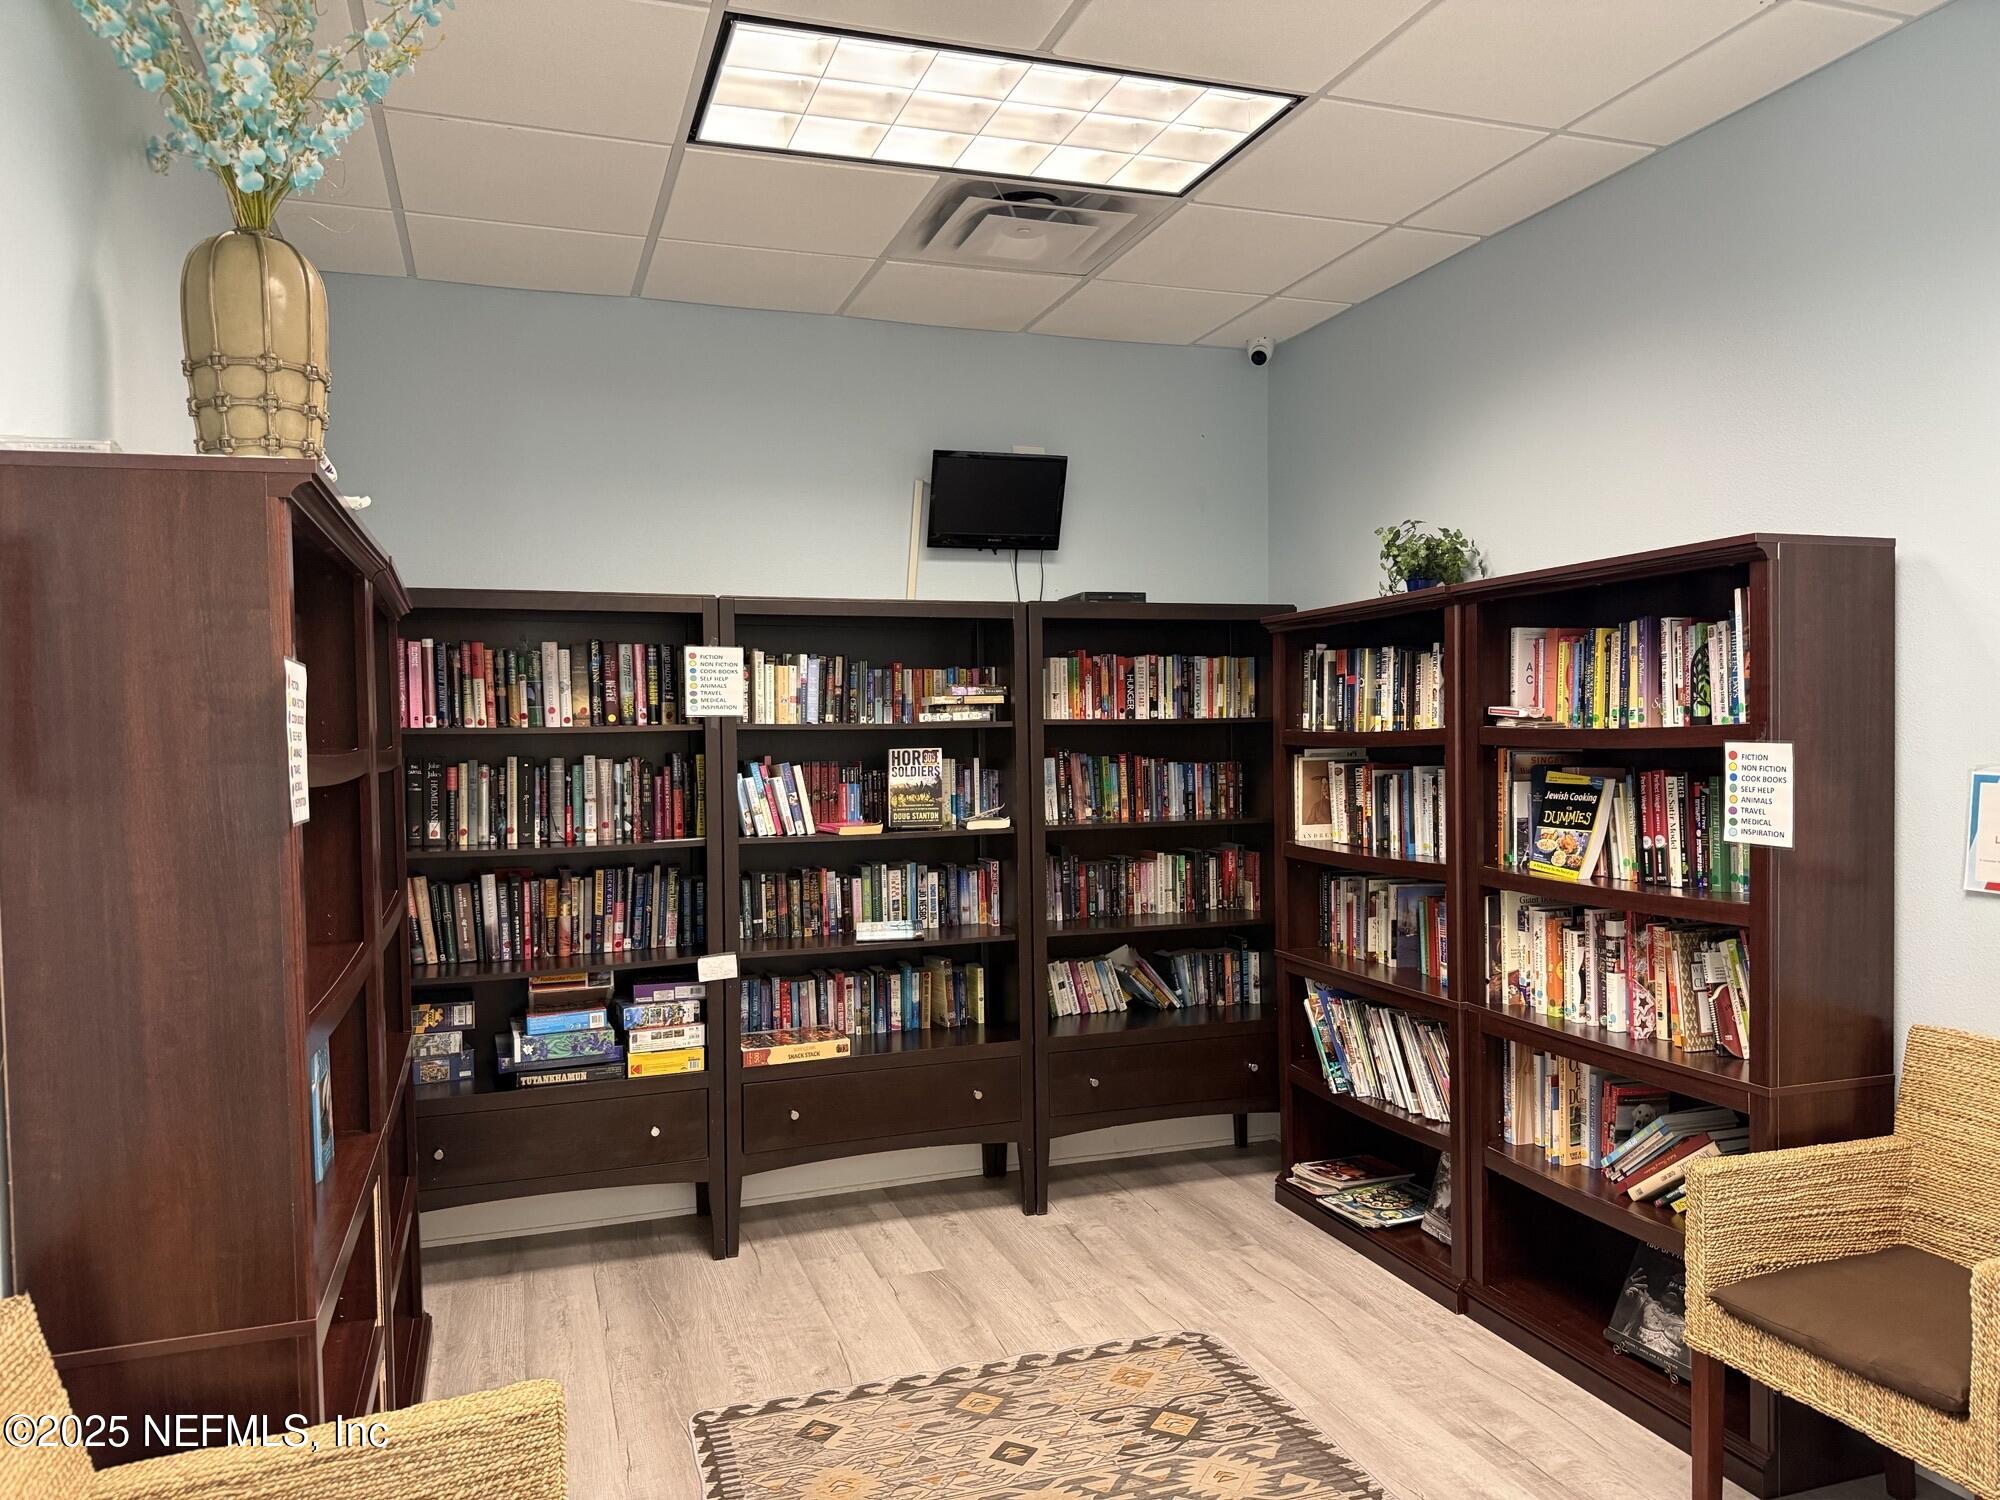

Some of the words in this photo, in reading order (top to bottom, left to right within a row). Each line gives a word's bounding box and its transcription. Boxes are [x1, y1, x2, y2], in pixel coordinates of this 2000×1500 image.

[892, 766, 940, 777] SOLDIERS
[1355, 768, 1363, 807] CATASTROPHE
[1545, 791, 1568, 800] Jewish
[1570, 792, 1597, 803] Cooking
[1544, 810, 1592, 825] DUMMIES
[1741, 829, 1785, 838] INSPIRATION
[1520, 896, 1538, 904] Giant
[520, 1072, 587, 1086] TUTANKHAMUN
